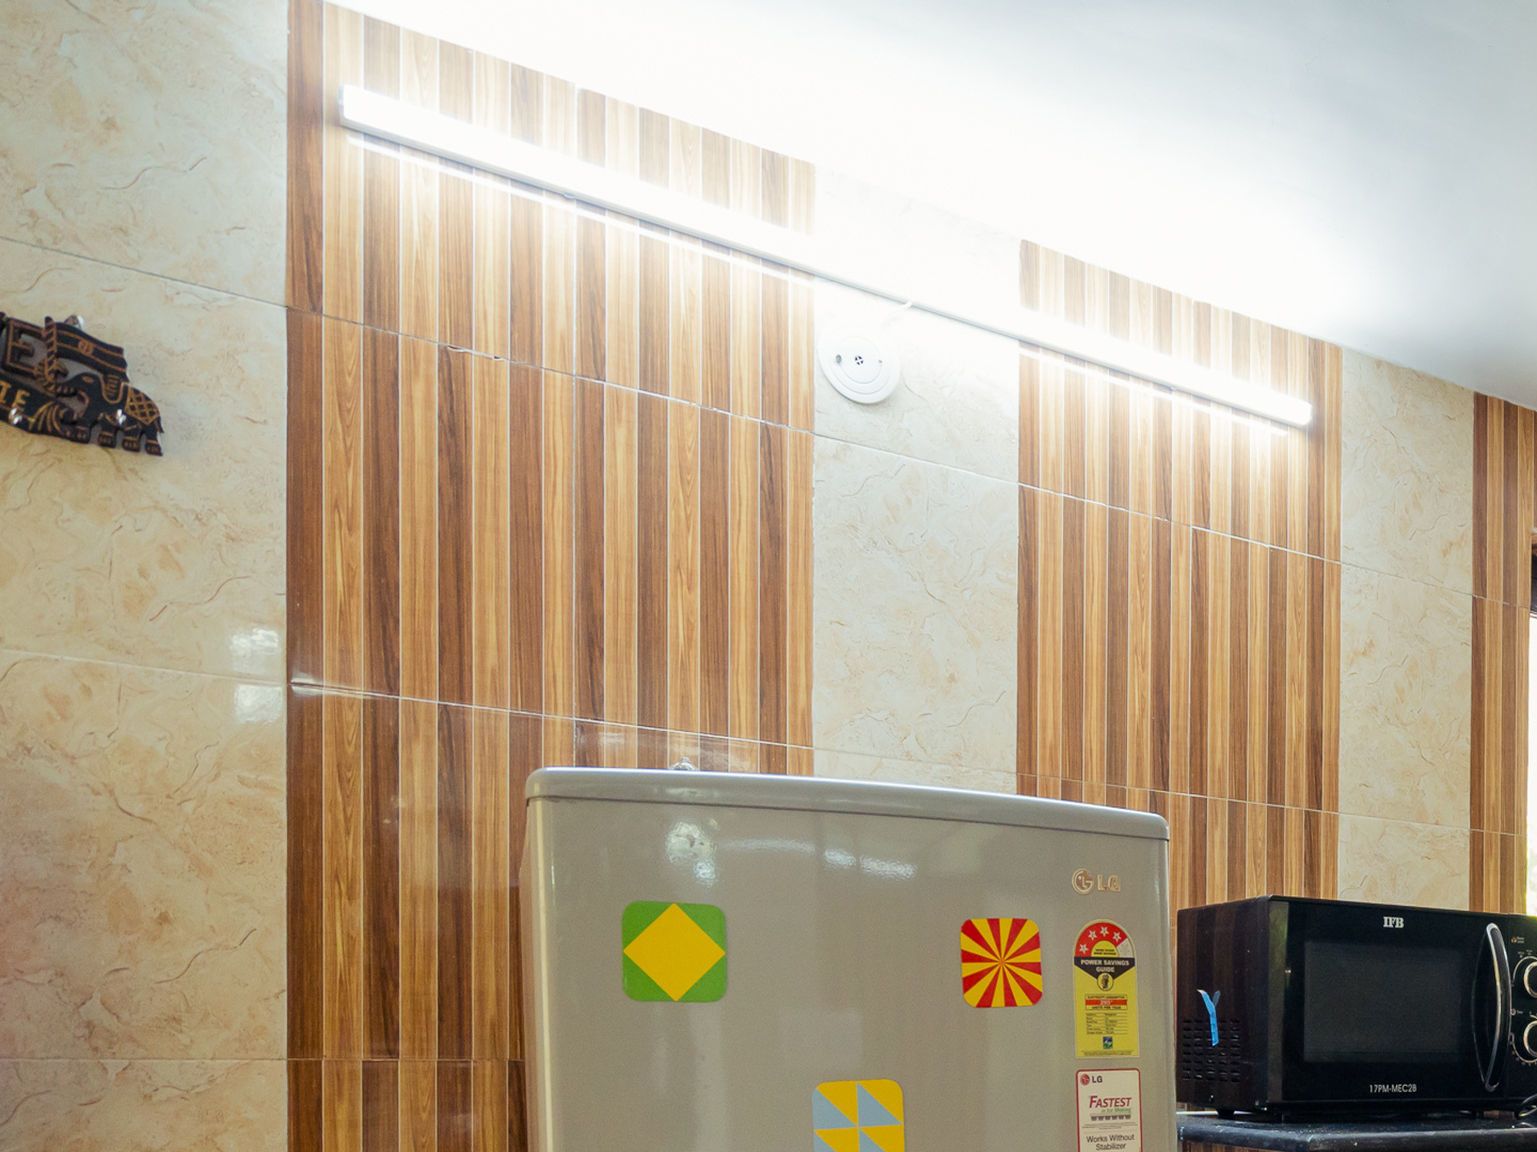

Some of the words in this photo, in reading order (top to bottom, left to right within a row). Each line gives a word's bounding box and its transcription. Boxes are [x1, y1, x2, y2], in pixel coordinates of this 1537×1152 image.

[1383, 916, 1405, 929] IFB
[1091, 1075, 1103, 1084] LG
[1089, 1095, 1132, 1109] FASTEST
[1109, 1133, 1136, 1142] Without
[1095, 1142, 1127, 1151] Stabilizer
